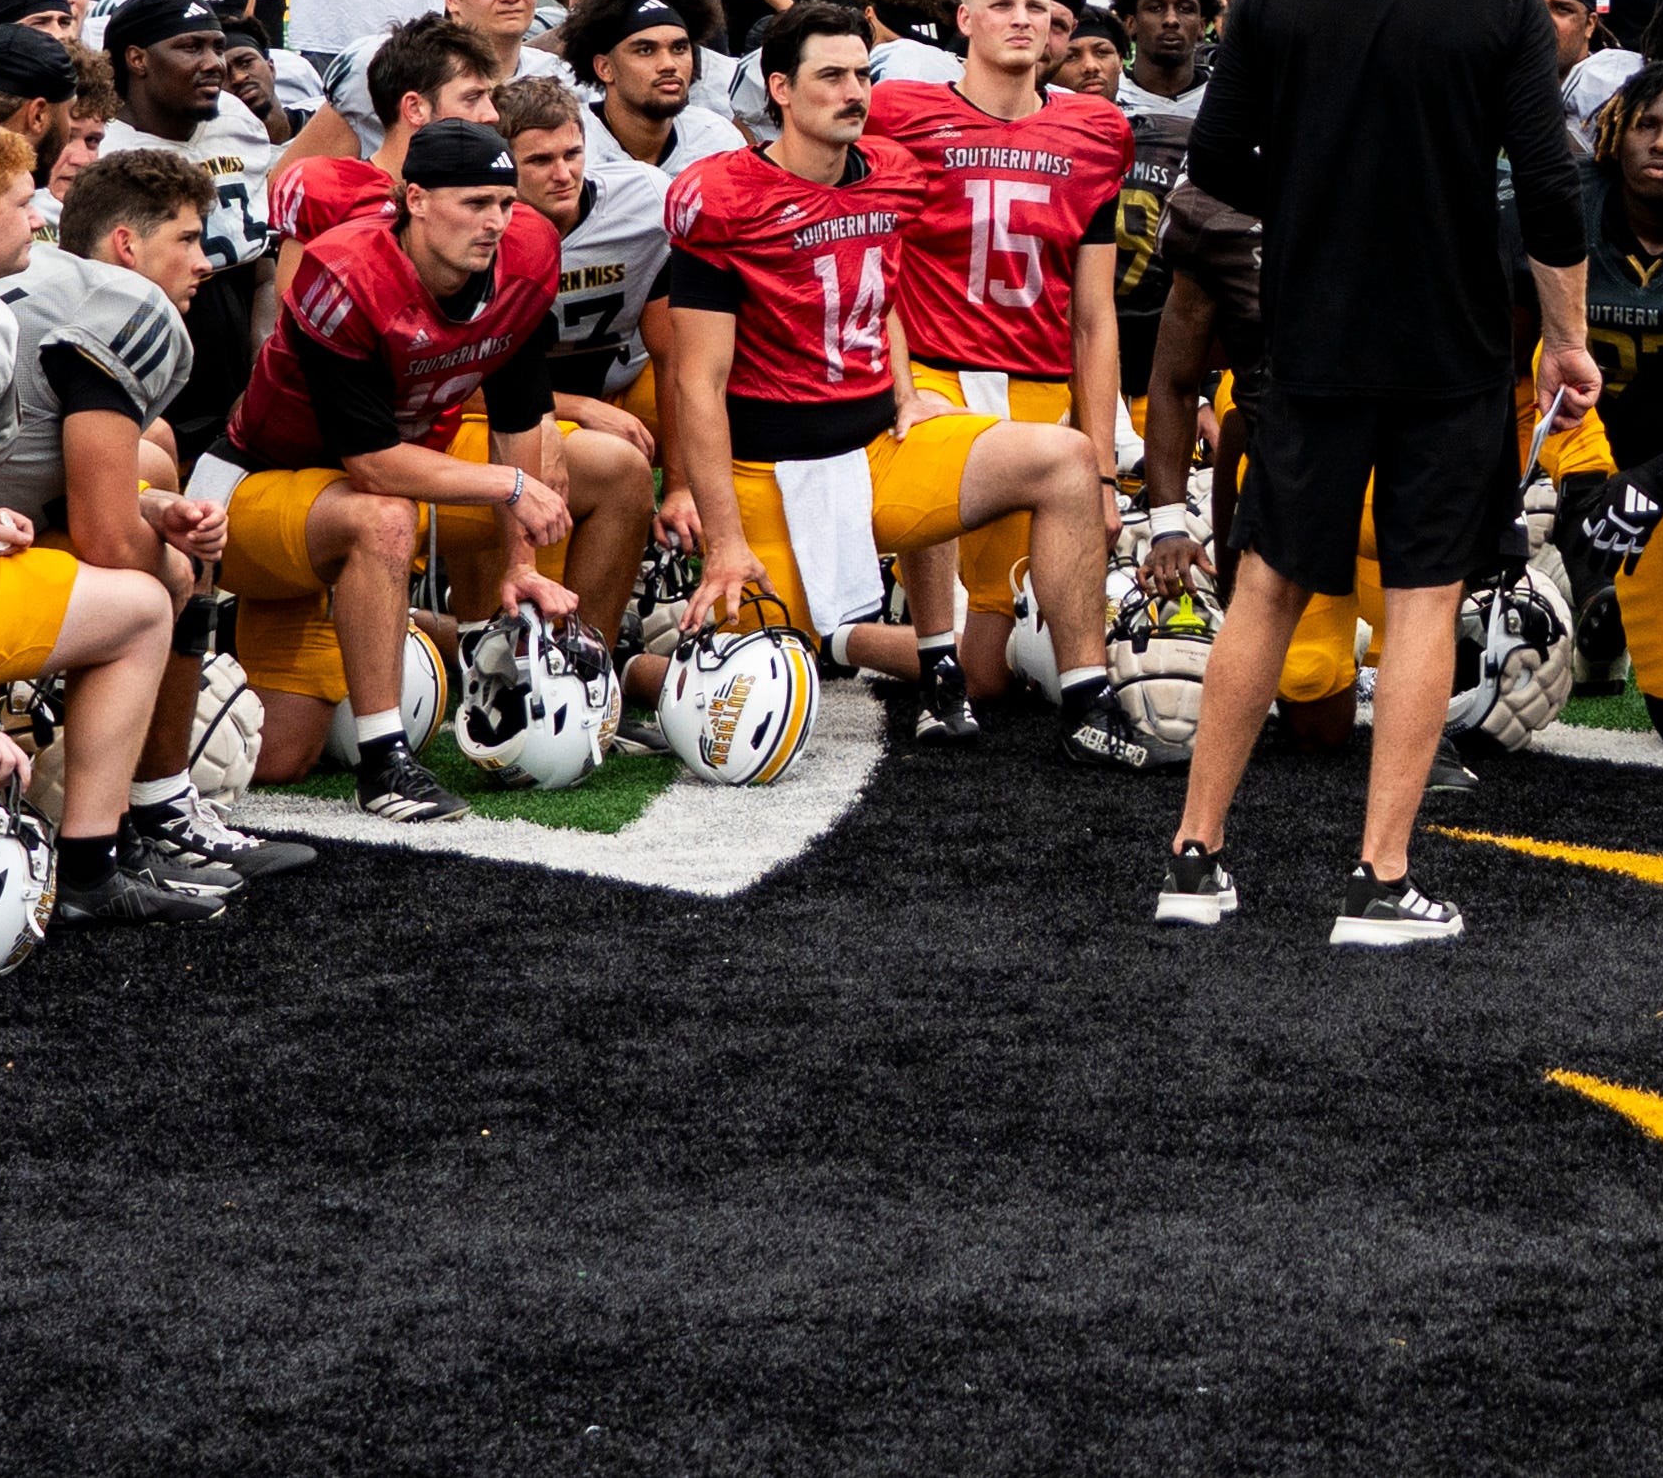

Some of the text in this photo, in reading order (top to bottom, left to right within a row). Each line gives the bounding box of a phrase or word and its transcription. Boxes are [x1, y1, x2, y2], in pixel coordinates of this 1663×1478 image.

[943, 146, 1074, 177] SOUTHERN MISS
[792, 212, 866, 250] SOUTHERN
[964, 178, 1052, 309] 15
[585, 263, 626, 286] MISS
[812, 246, 887, 383] 14
[1589, 304, 1659, 327] UTHERN
[404, 333, 515, 376] SOUTHERN MISS
[710, 672, 757, 766] SOUTHERN
